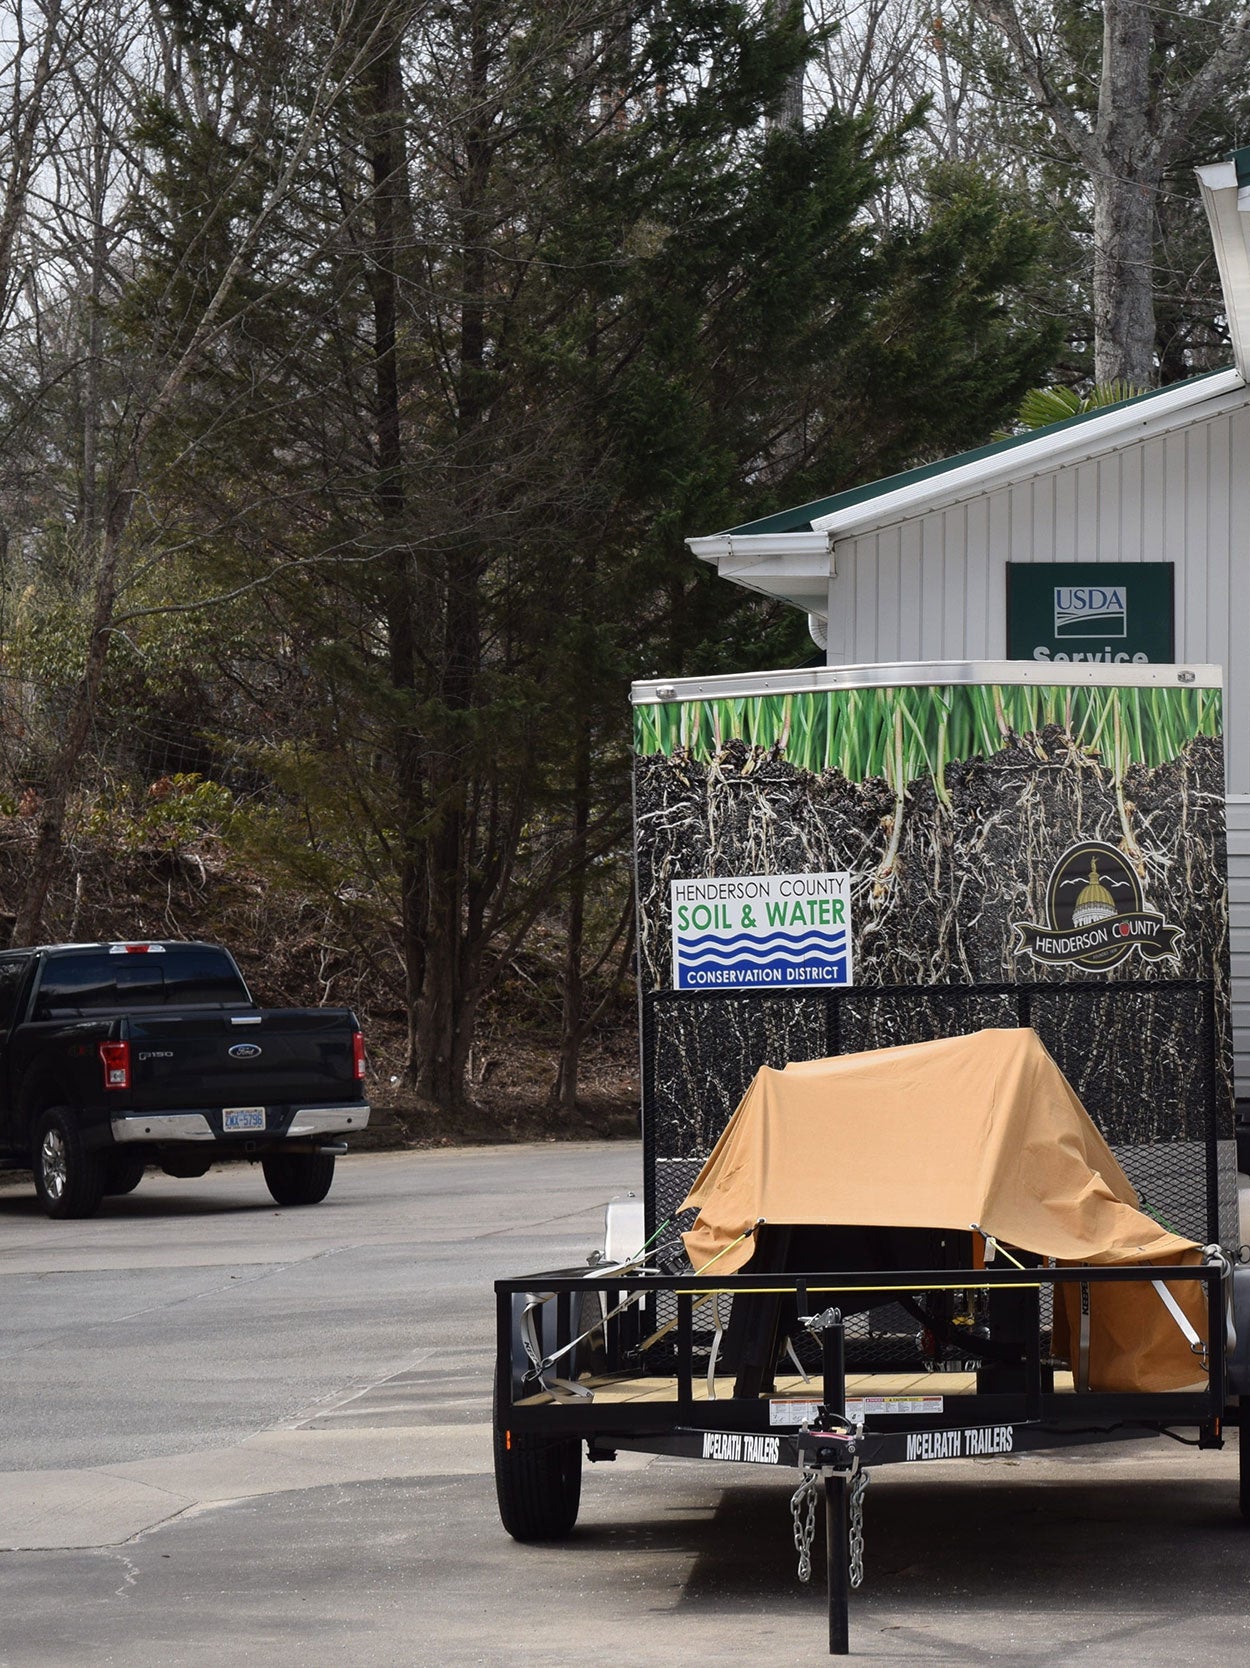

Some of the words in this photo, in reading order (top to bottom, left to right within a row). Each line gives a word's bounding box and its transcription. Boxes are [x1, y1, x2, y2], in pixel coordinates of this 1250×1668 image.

[1056, 589, 1124, 610] USDA
[1033, 646, 1149, 664] Service
[675, 881, 770, 902] HENDERSON
[779, 878, 845, 897] COUNTY
[677, 904, 732, 931] SOIL
[740, 904, 758, 928] &
[765, 899, 846, 927] WATER
[1035, 927, 1108, 954] HENDERSON
[687, 968, 782, 984] CONSERVATION
[786, 966, 839, 981] DISTRICT
[743, 1435, 780, 1464] TRAILERS
[964, 1425, 1013, 1455] TRAILERS
